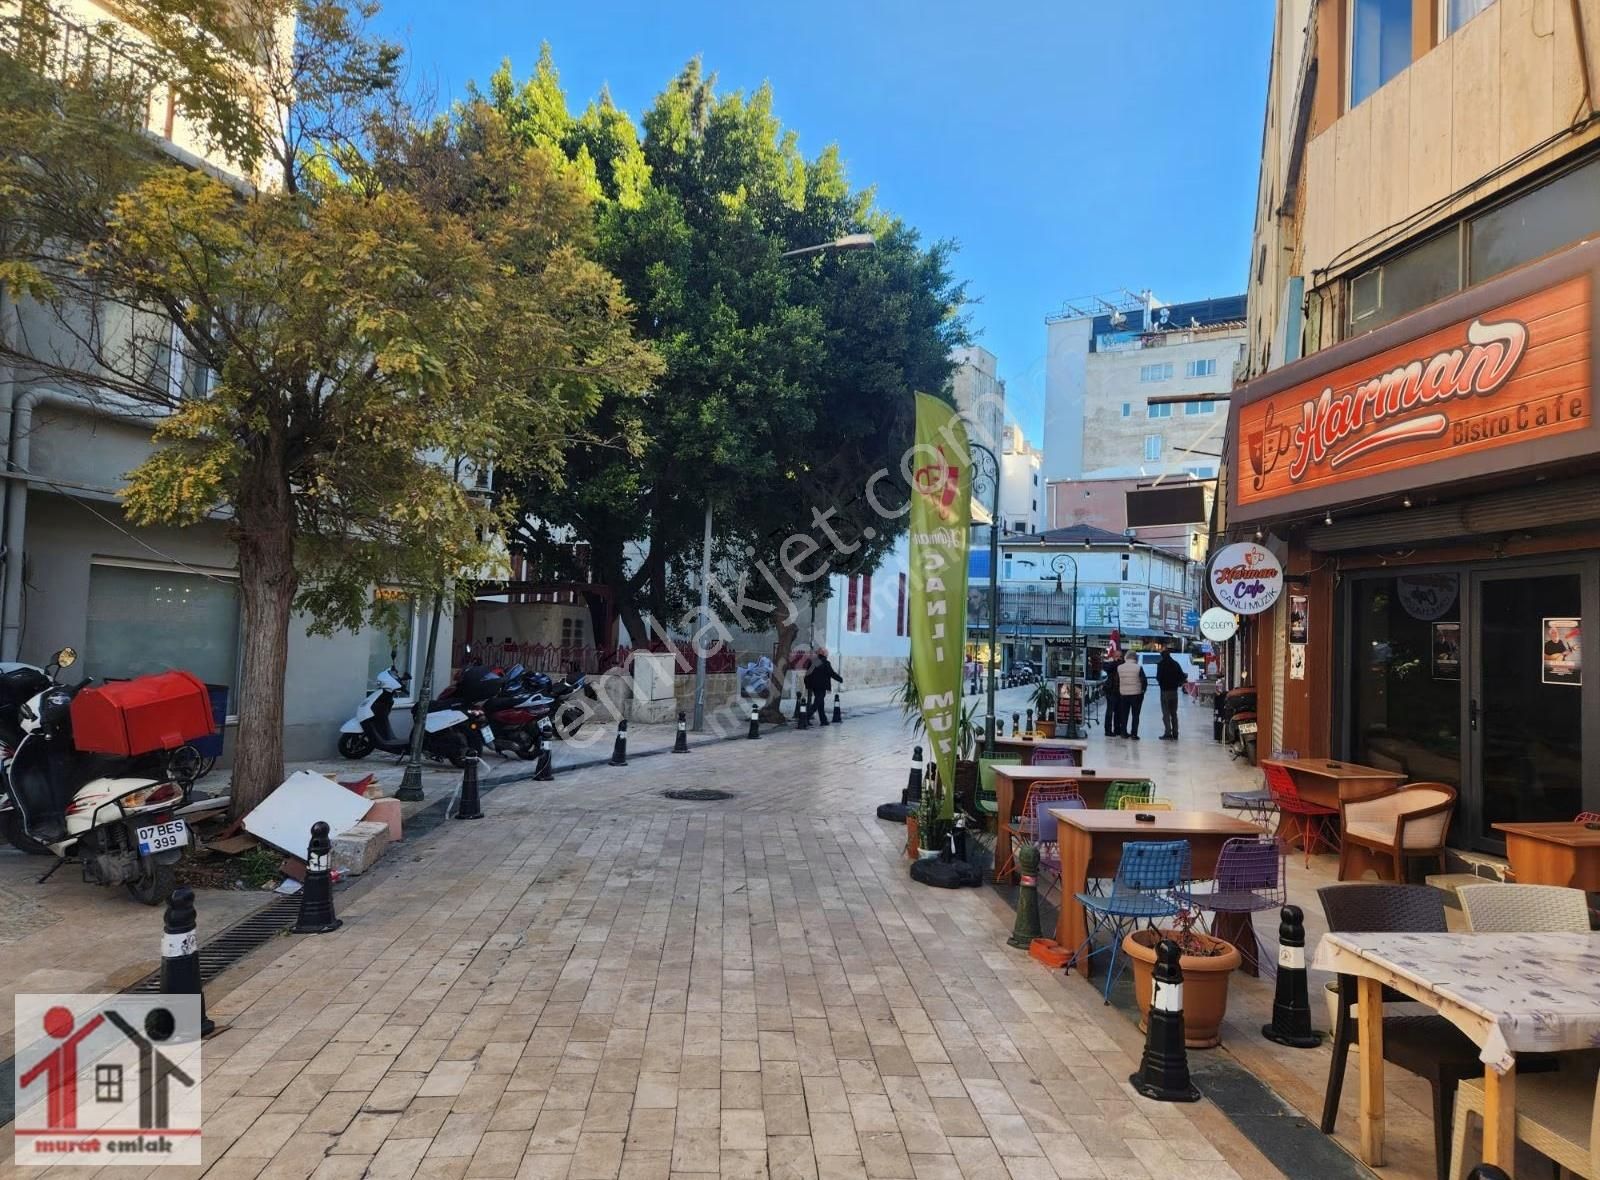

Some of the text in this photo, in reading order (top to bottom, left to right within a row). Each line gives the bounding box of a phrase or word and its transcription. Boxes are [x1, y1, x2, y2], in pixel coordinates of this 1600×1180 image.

[1289, 318, 1528, 480] Harman
[1453, 415, 1510, 445] Bistro
[1214, 565, 1278, 584] Harman
[1234, 580, 1266, 598] Cafe
[1219, 589, 1246, 609] CANLI
[140, 822, 183, 839] 07 BES
[154, 836, 177, 849] 399
